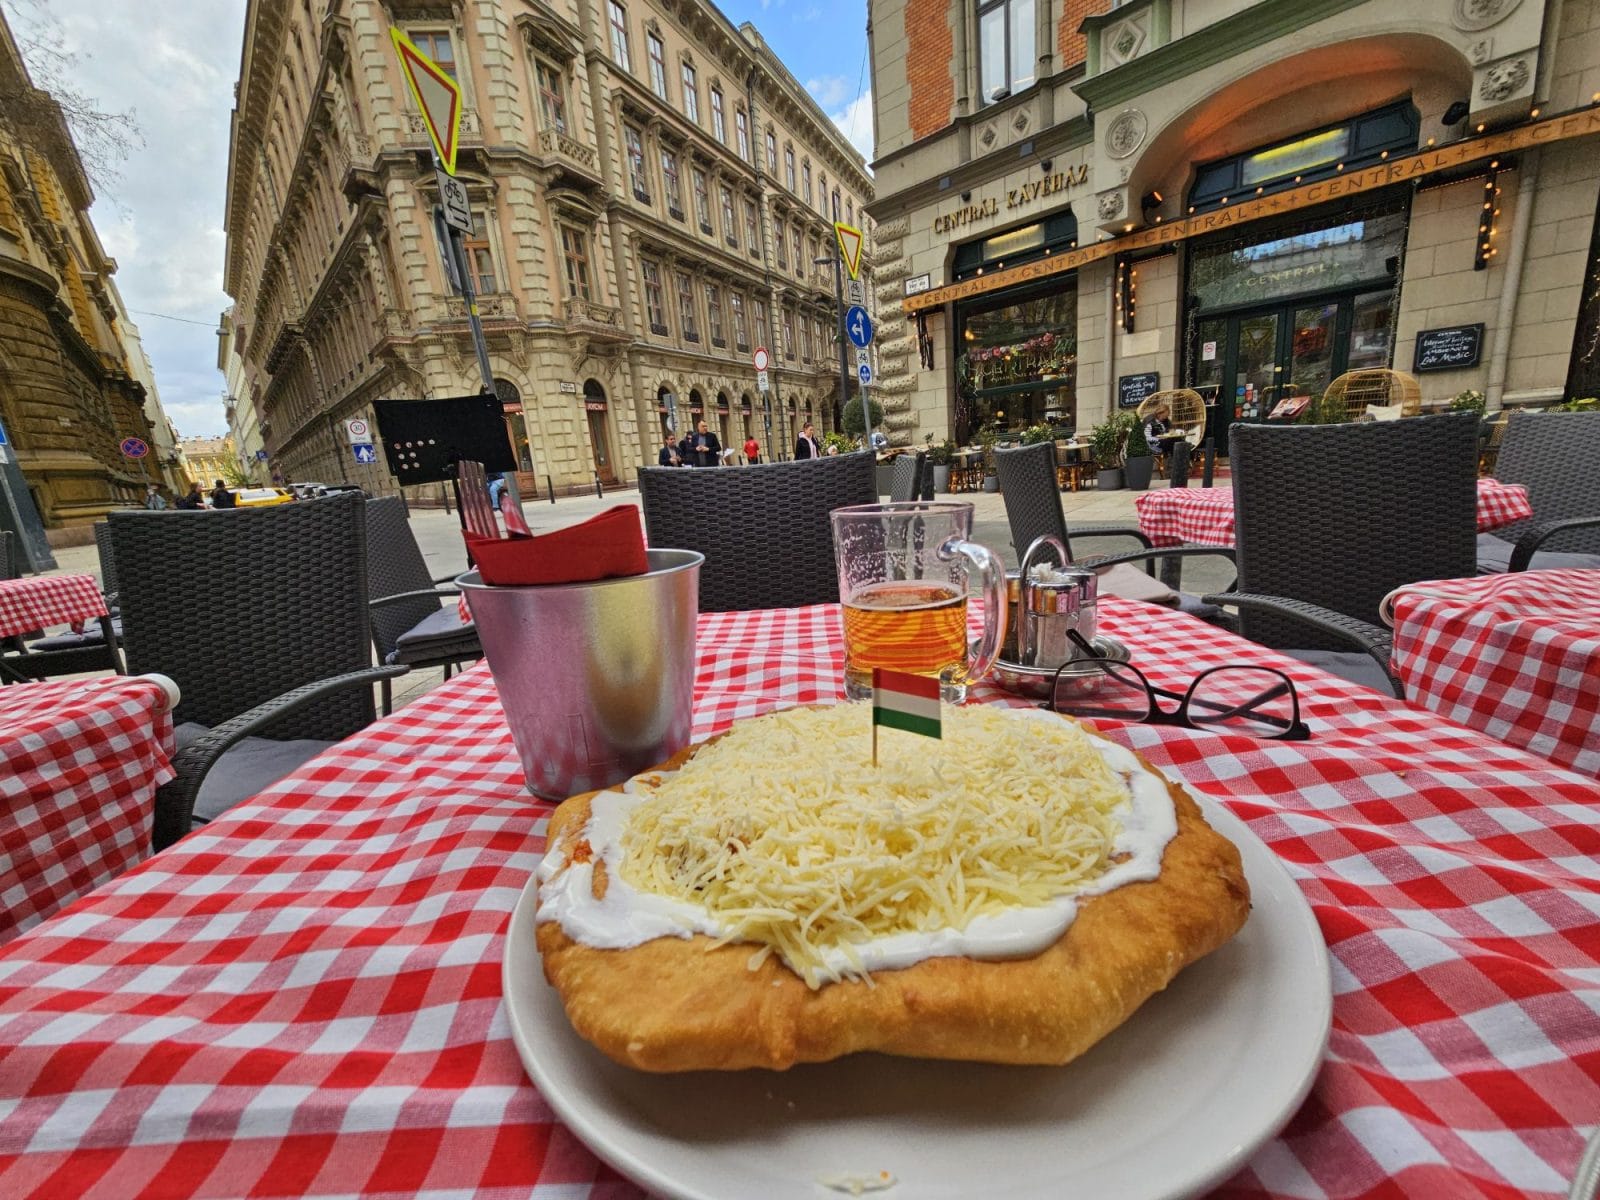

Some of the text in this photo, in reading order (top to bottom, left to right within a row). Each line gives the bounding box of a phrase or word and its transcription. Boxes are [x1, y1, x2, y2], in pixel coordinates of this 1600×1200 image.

[924, 280, 986, 304] CENTRAL
[1021, 249, 1099, 277] CENTRAL
[1144, 208, 1247, 243] CENTRAL
[1307, 154, 1447, 201] CENTRAL
[1246, 264, 1327, 287] CENTRAL
